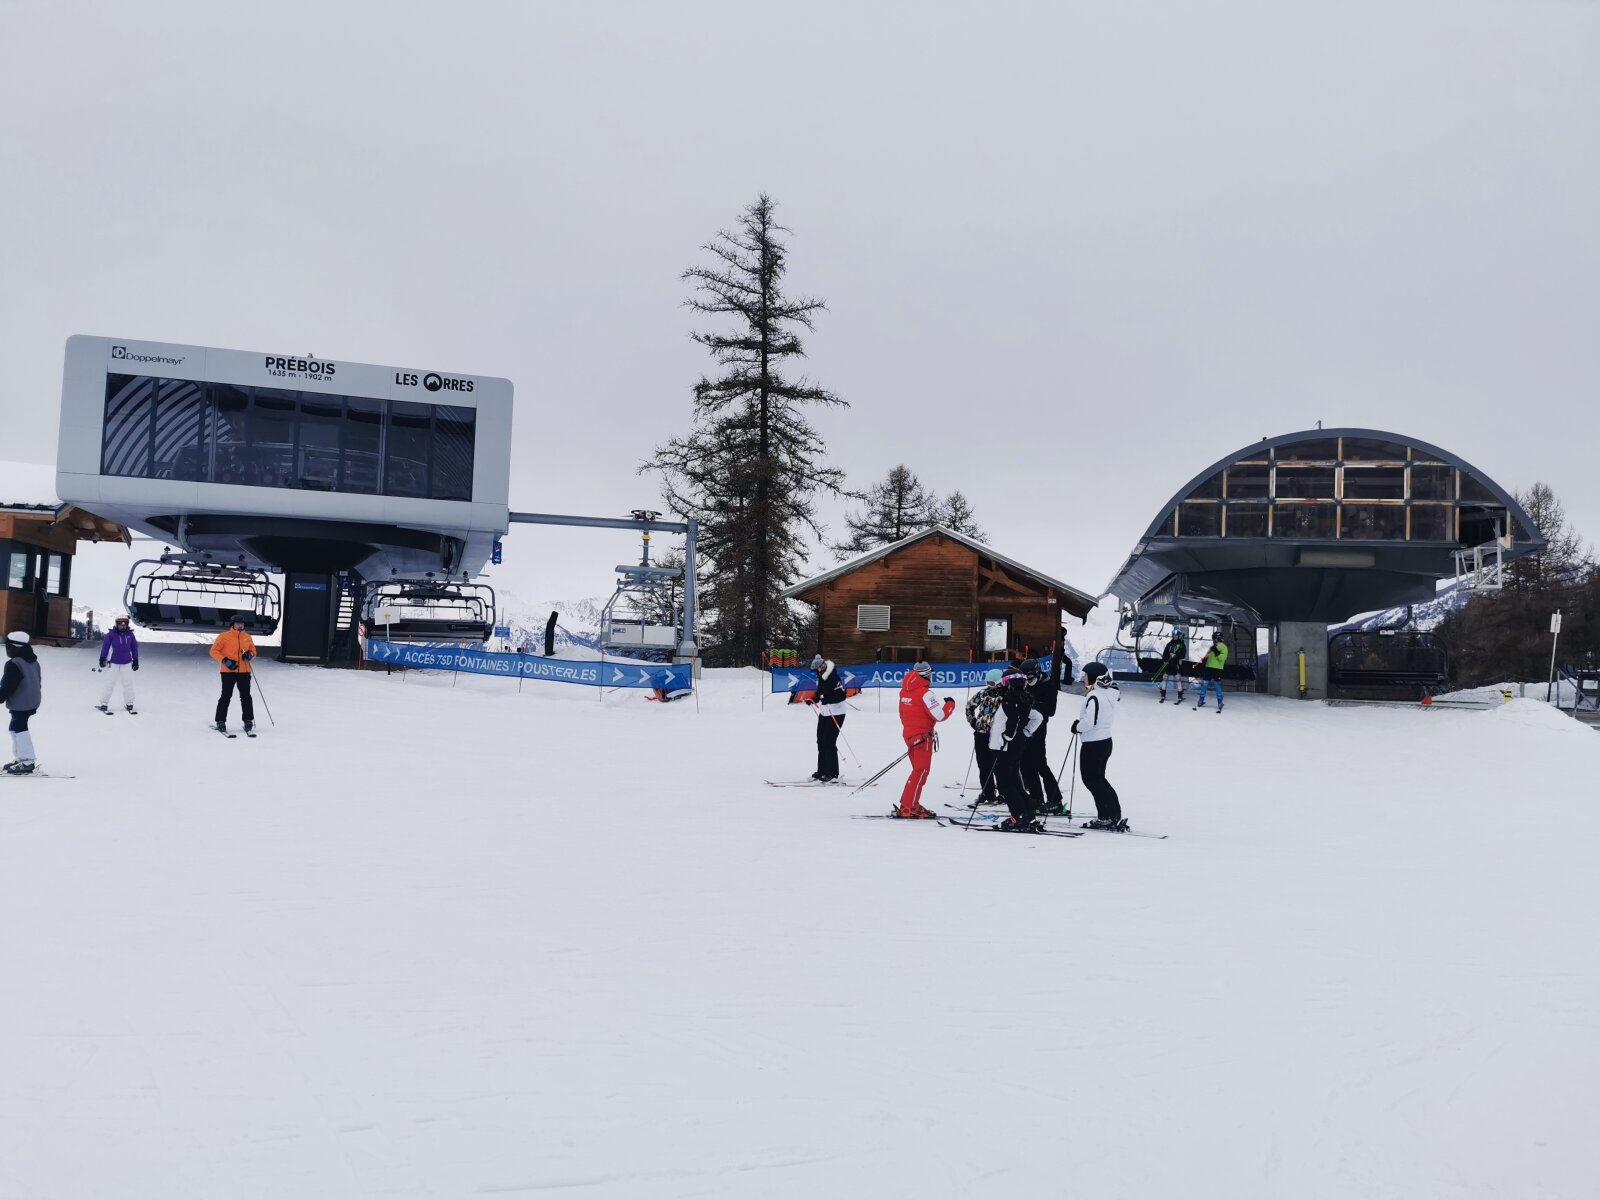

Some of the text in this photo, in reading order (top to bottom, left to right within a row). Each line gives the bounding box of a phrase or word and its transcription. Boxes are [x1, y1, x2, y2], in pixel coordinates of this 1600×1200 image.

[126, 353, 183, 365] Doppelmayr
[265, 356, 336, 375] PRÉBOIS
[268, 369, 287, 377] 1635
[305, 373, 322, 381] 1902
[395, 372, 474, 393] LES ORRES
[403, 651, 436, 665] ACCÈS
[454, 655, 509, 672] FONTAINES
[517, 661, 597, 681] POUSTERLES
[871, 668, 910, 683] ACC
